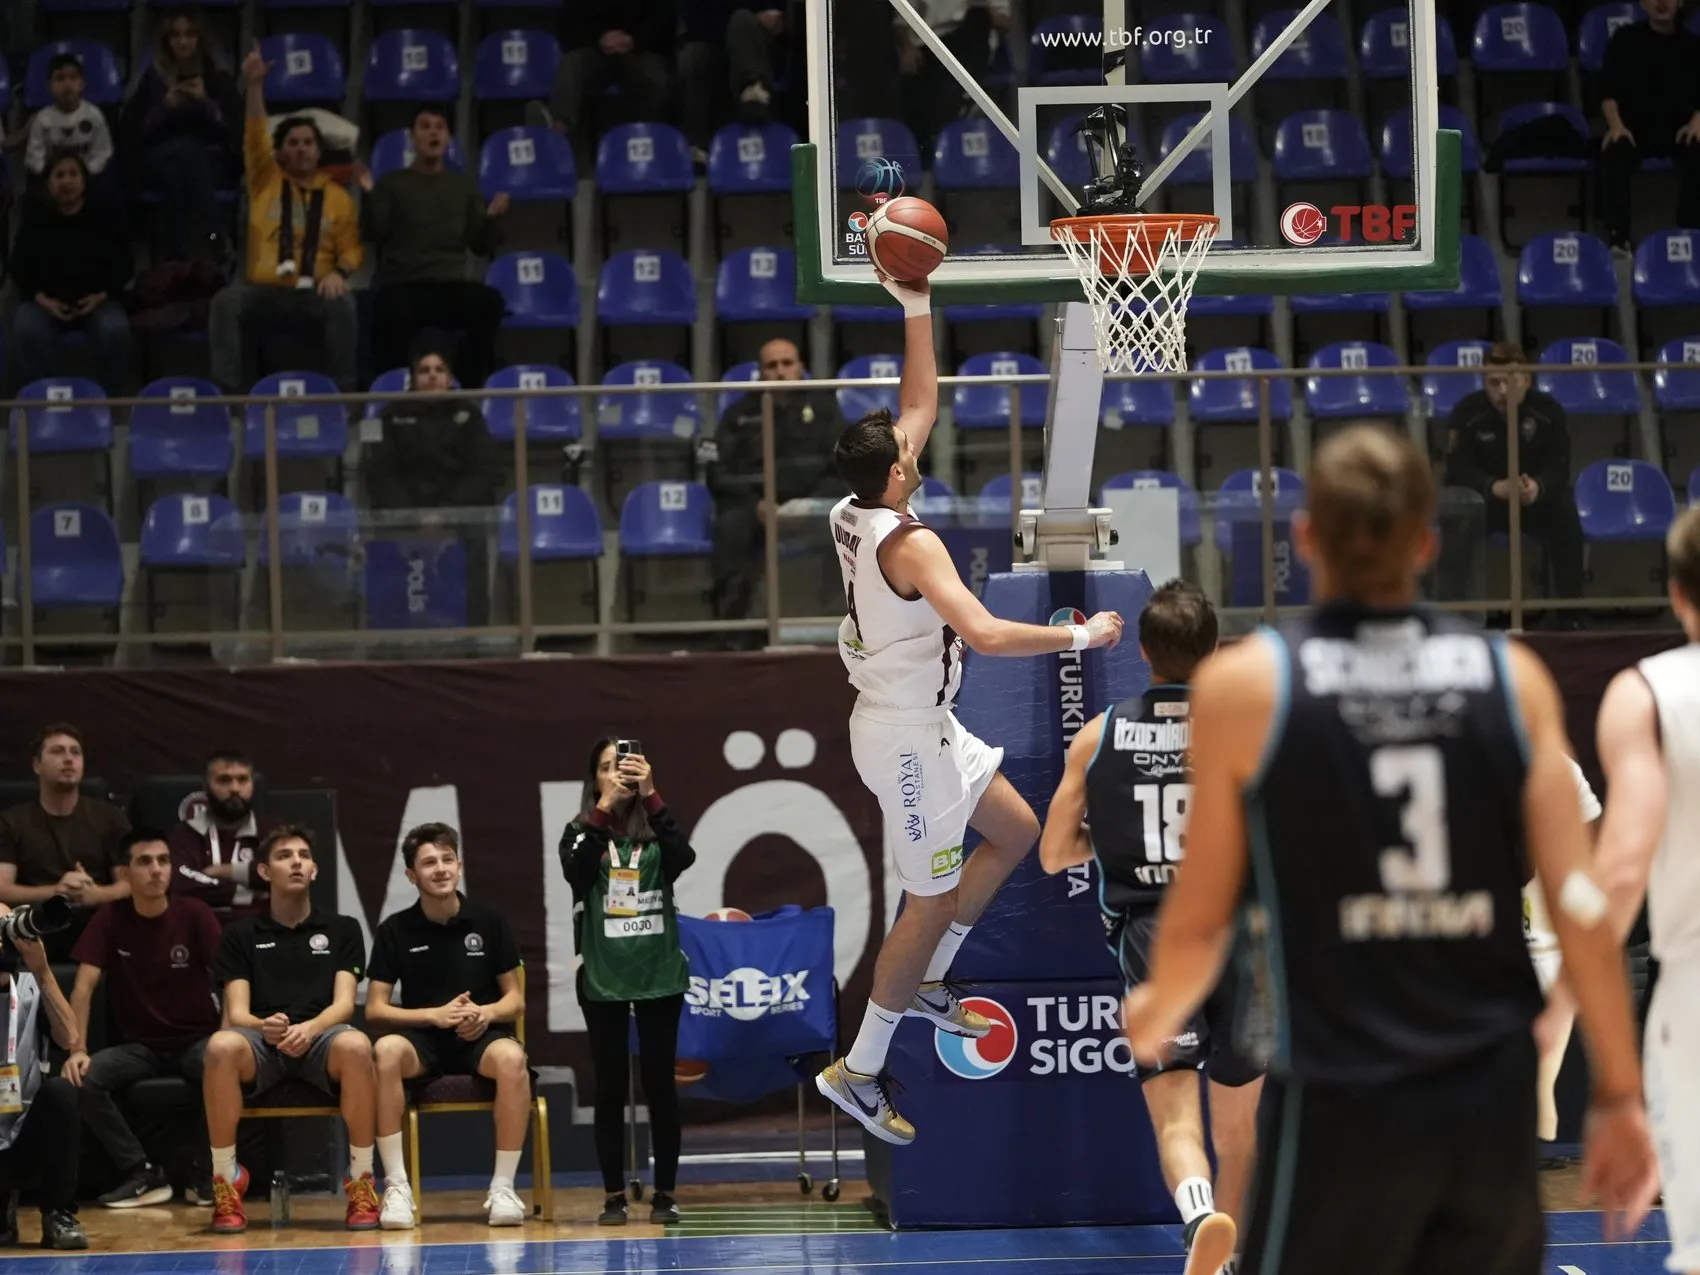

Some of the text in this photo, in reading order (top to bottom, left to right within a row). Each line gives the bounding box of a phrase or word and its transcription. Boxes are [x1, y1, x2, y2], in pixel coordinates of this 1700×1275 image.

[1502, 22, 1524, 36] 20
[1040, 26, 1213, 51] www.tbf.org.tr
[513, 143, 534, 159] 11
[631, 144, 650, 159] 12
[1330, 204, 1417, 242] TBF
[1556, 244, 1577, 258] 20
[1670, 241, 1690, 257] 21
[522, 262, 543, 279] 11
[638, 260, 659, 277] 12
[754, 257, 775, 274] 13
[1461, 351, 1482, 367] 19
[1573, 348, 1595, 363] 20
[1609, 470, 1631, 486] 20
[541, 494, 562, 510] 11
[661, 491, 684, 507] 12
[308, 501, 321, 517] 9
[63, 515, 74, 533] 7
[899, 744, 917, 808] ROYAL
[1133, 783, 1194, 863] 18
[1370, 744, 1448, 893] 3
[623, 919, 652, 933] 0030
[689, 1000, 805, 1017] SPORT SERIES
[1027, 995, 1127, 1032] TÜR
